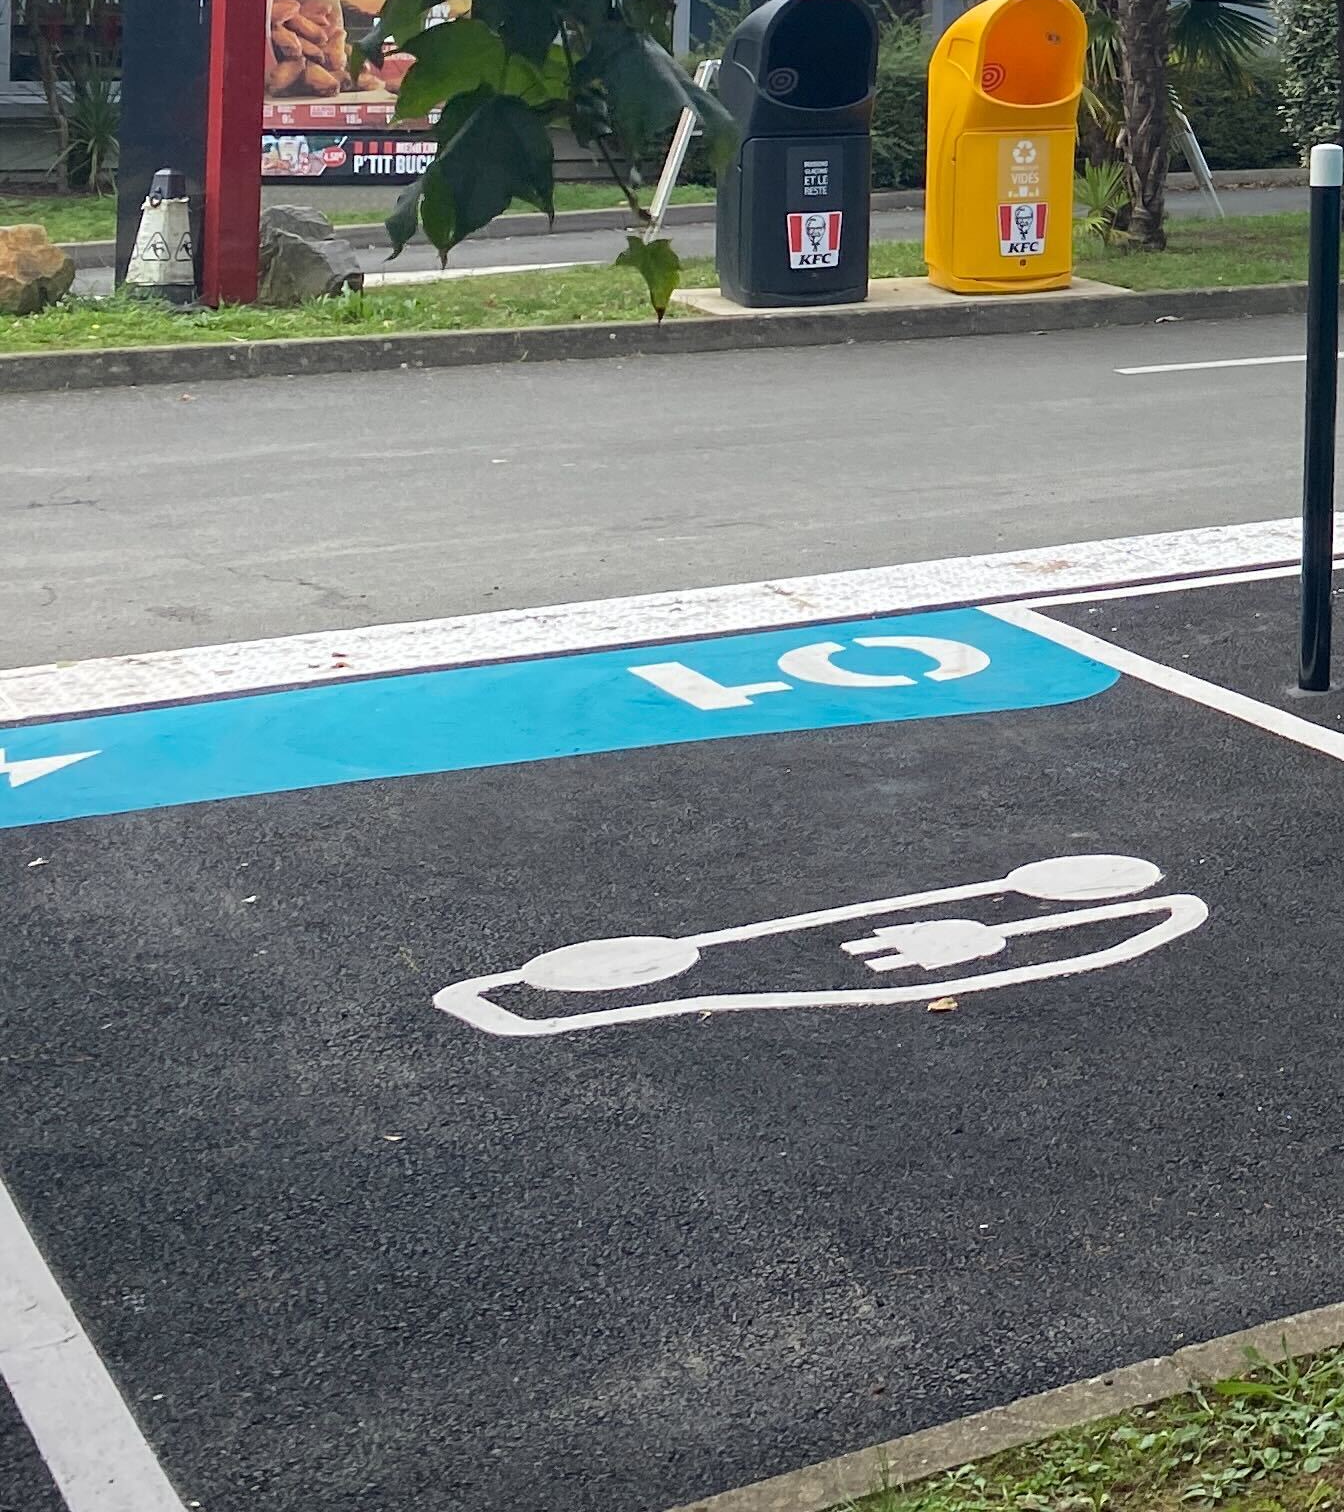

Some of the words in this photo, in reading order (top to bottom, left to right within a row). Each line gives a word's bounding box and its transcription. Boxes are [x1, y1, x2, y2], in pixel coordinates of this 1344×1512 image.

[353, 154, 394, 174] P'TIT
[804, 175, 816, 186] ET
[817, 174, 828, 185] LE
[1008, 241, 1039, 253] KFC
[798, 253, 831, 266] KFC
